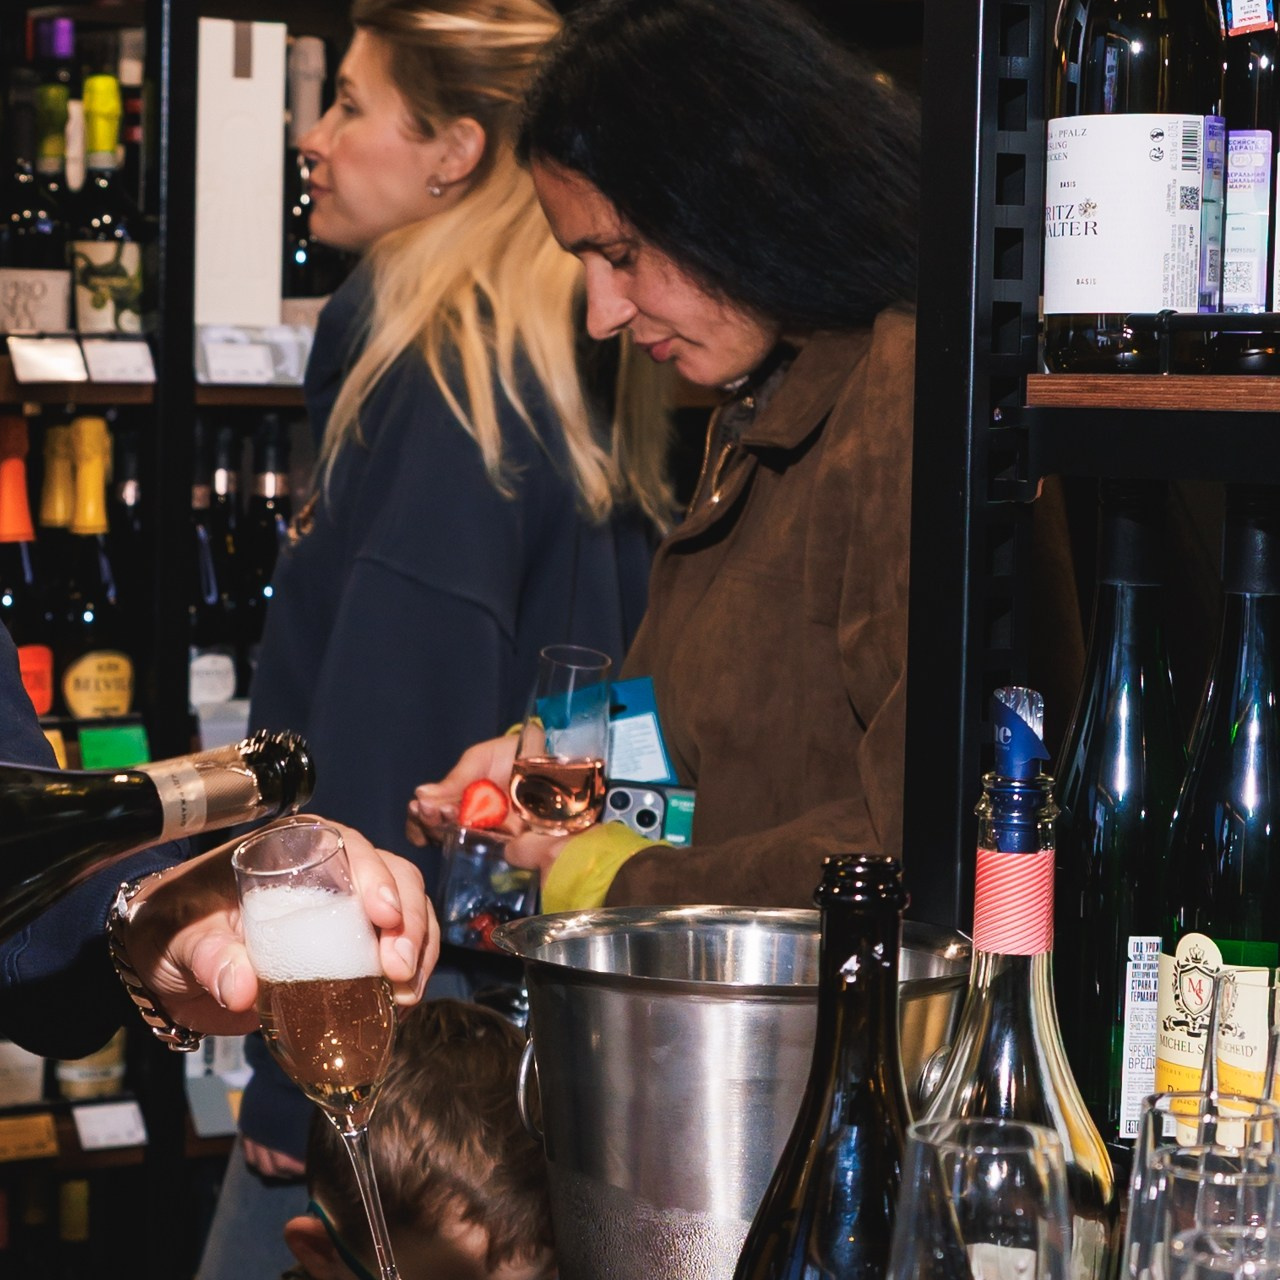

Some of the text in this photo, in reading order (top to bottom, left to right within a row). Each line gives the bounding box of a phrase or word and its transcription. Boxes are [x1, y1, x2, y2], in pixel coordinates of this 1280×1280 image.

[1058, 128, 1088, 138] PFALZ
[1060, 181, 1077, 189] BASIS
[1076, 278, 1097, 286] BASIS
[1131, 980, 1151, 991] СТРАНА
[1159, 1035, 1194, 1053] MICHEL
